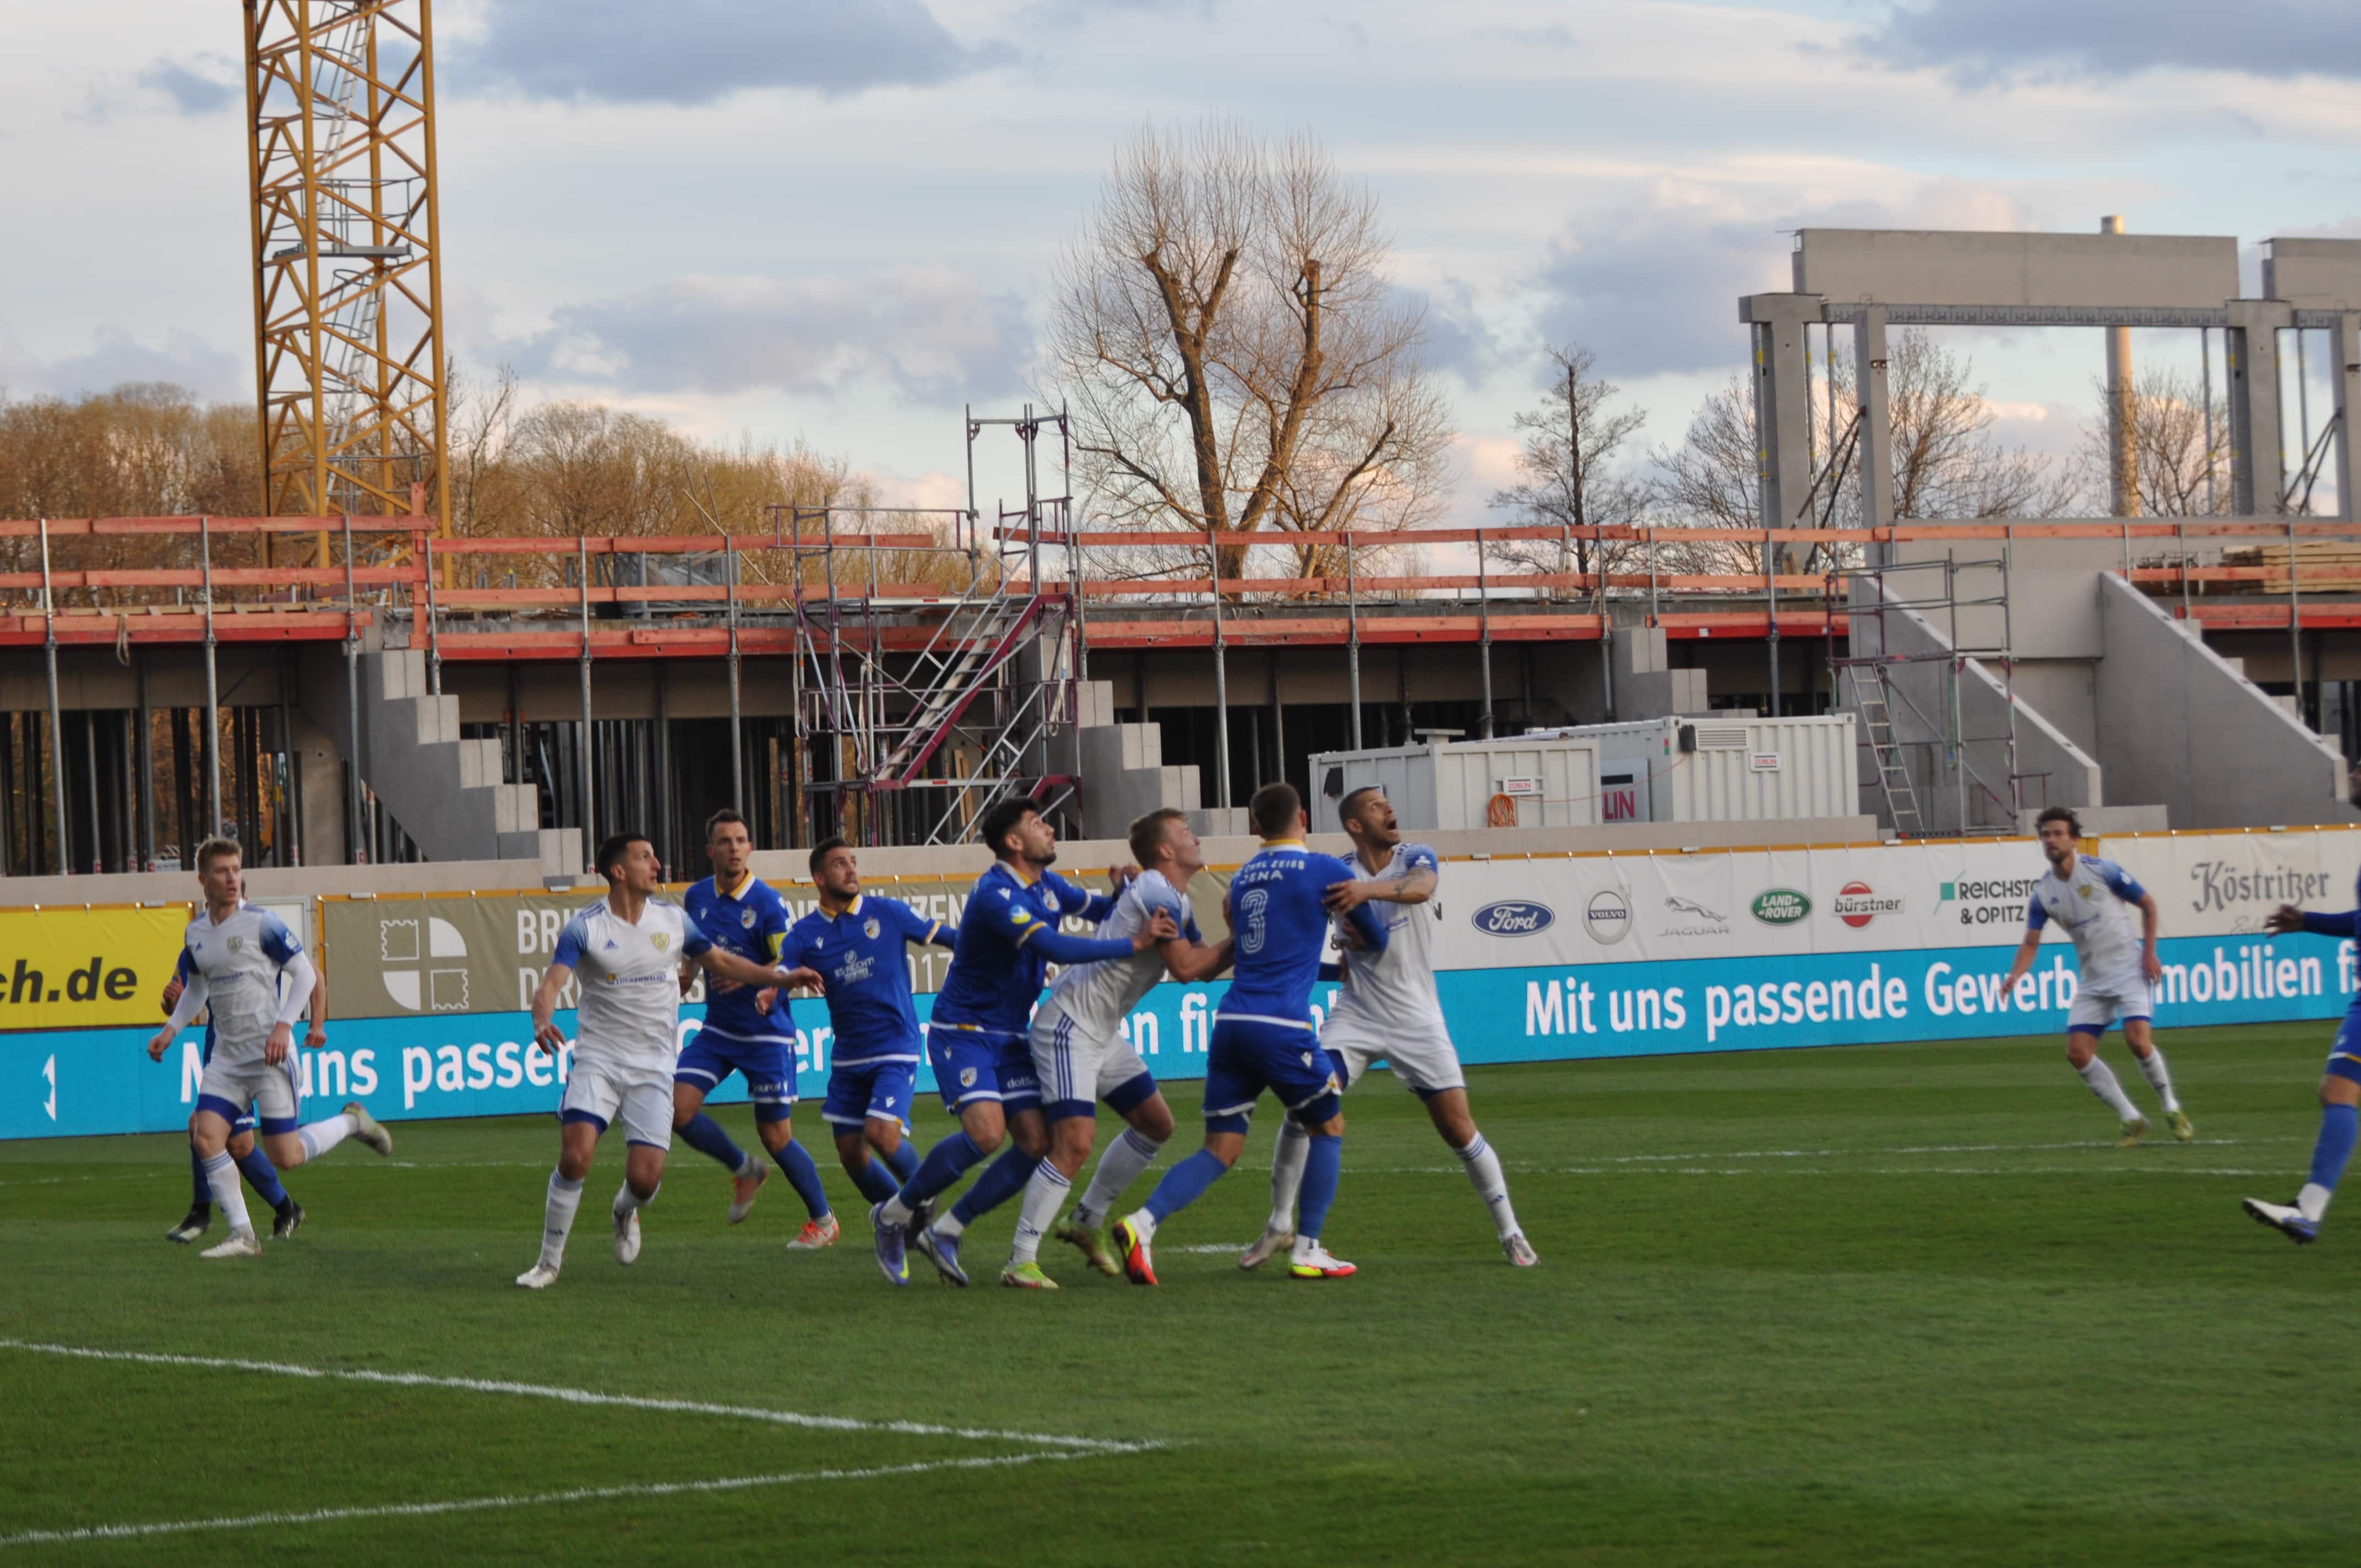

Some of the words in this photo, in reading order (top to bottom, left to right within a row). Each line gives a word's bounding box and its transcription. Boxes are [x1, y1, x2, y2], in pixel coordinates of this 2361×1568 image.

[1603, 791, 1635, 820] LIN
[1239, 869, 1283, 885] JENA
[2191, 861, 2330, 912] Köstritzer
[1761, 895, 1794, 907] LAND
[1835, 898, 1901, 913] bürstner
[1241, 888, 1268, 954] 3
[1489, 906, 1538, 930] Ford
[1590, 910, 1625, 919] VOLVO
[1765, 906, 1802, 919] ROVER
[1961, 908, 1973, 925] &
[1976, 906, 2025, 924] OPITZ
[1658, 925, 1731, 937] JAGUAR
[1526, 976, 1597, 1036] Mit
[1609, 987, 1686, 1032] uns
[1705, 962, 1908, 1043] passende
